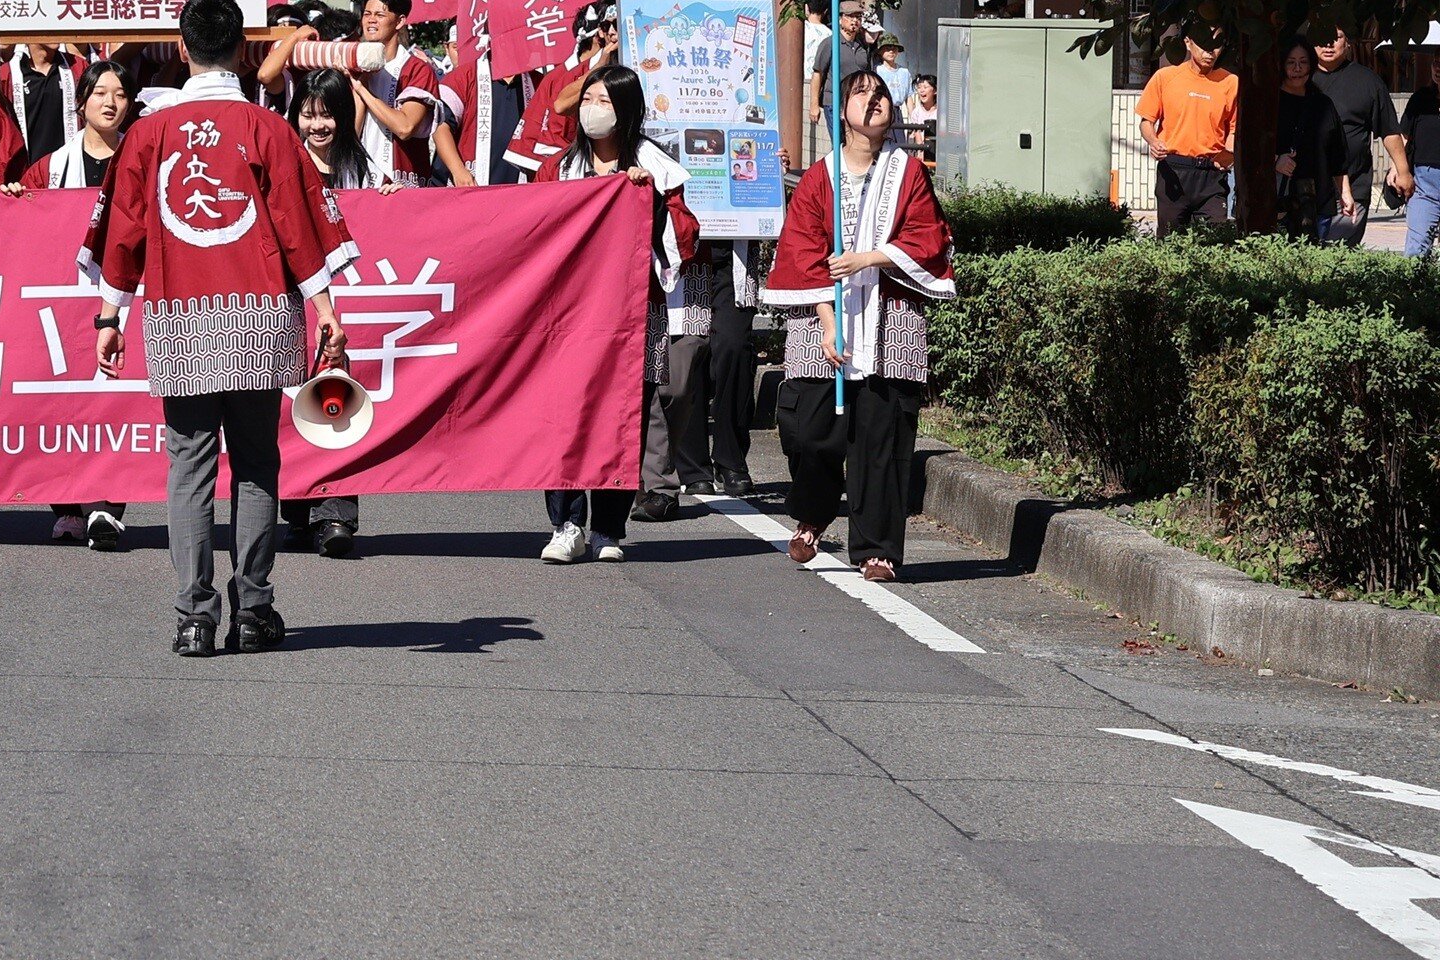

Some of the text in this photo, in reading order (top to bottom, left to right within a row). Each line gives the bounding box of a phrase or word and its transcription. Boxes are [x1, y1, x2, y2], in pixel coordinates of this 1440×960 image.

[667, 46, 732, 70] 岐協祭
[479, 74, 491, 142] 岐阜協立大学
[179, 118, 222, 220] 協立大
[890, 157, 899, 178] GIFU
[878, 180, 894, 221] KYORITSU
